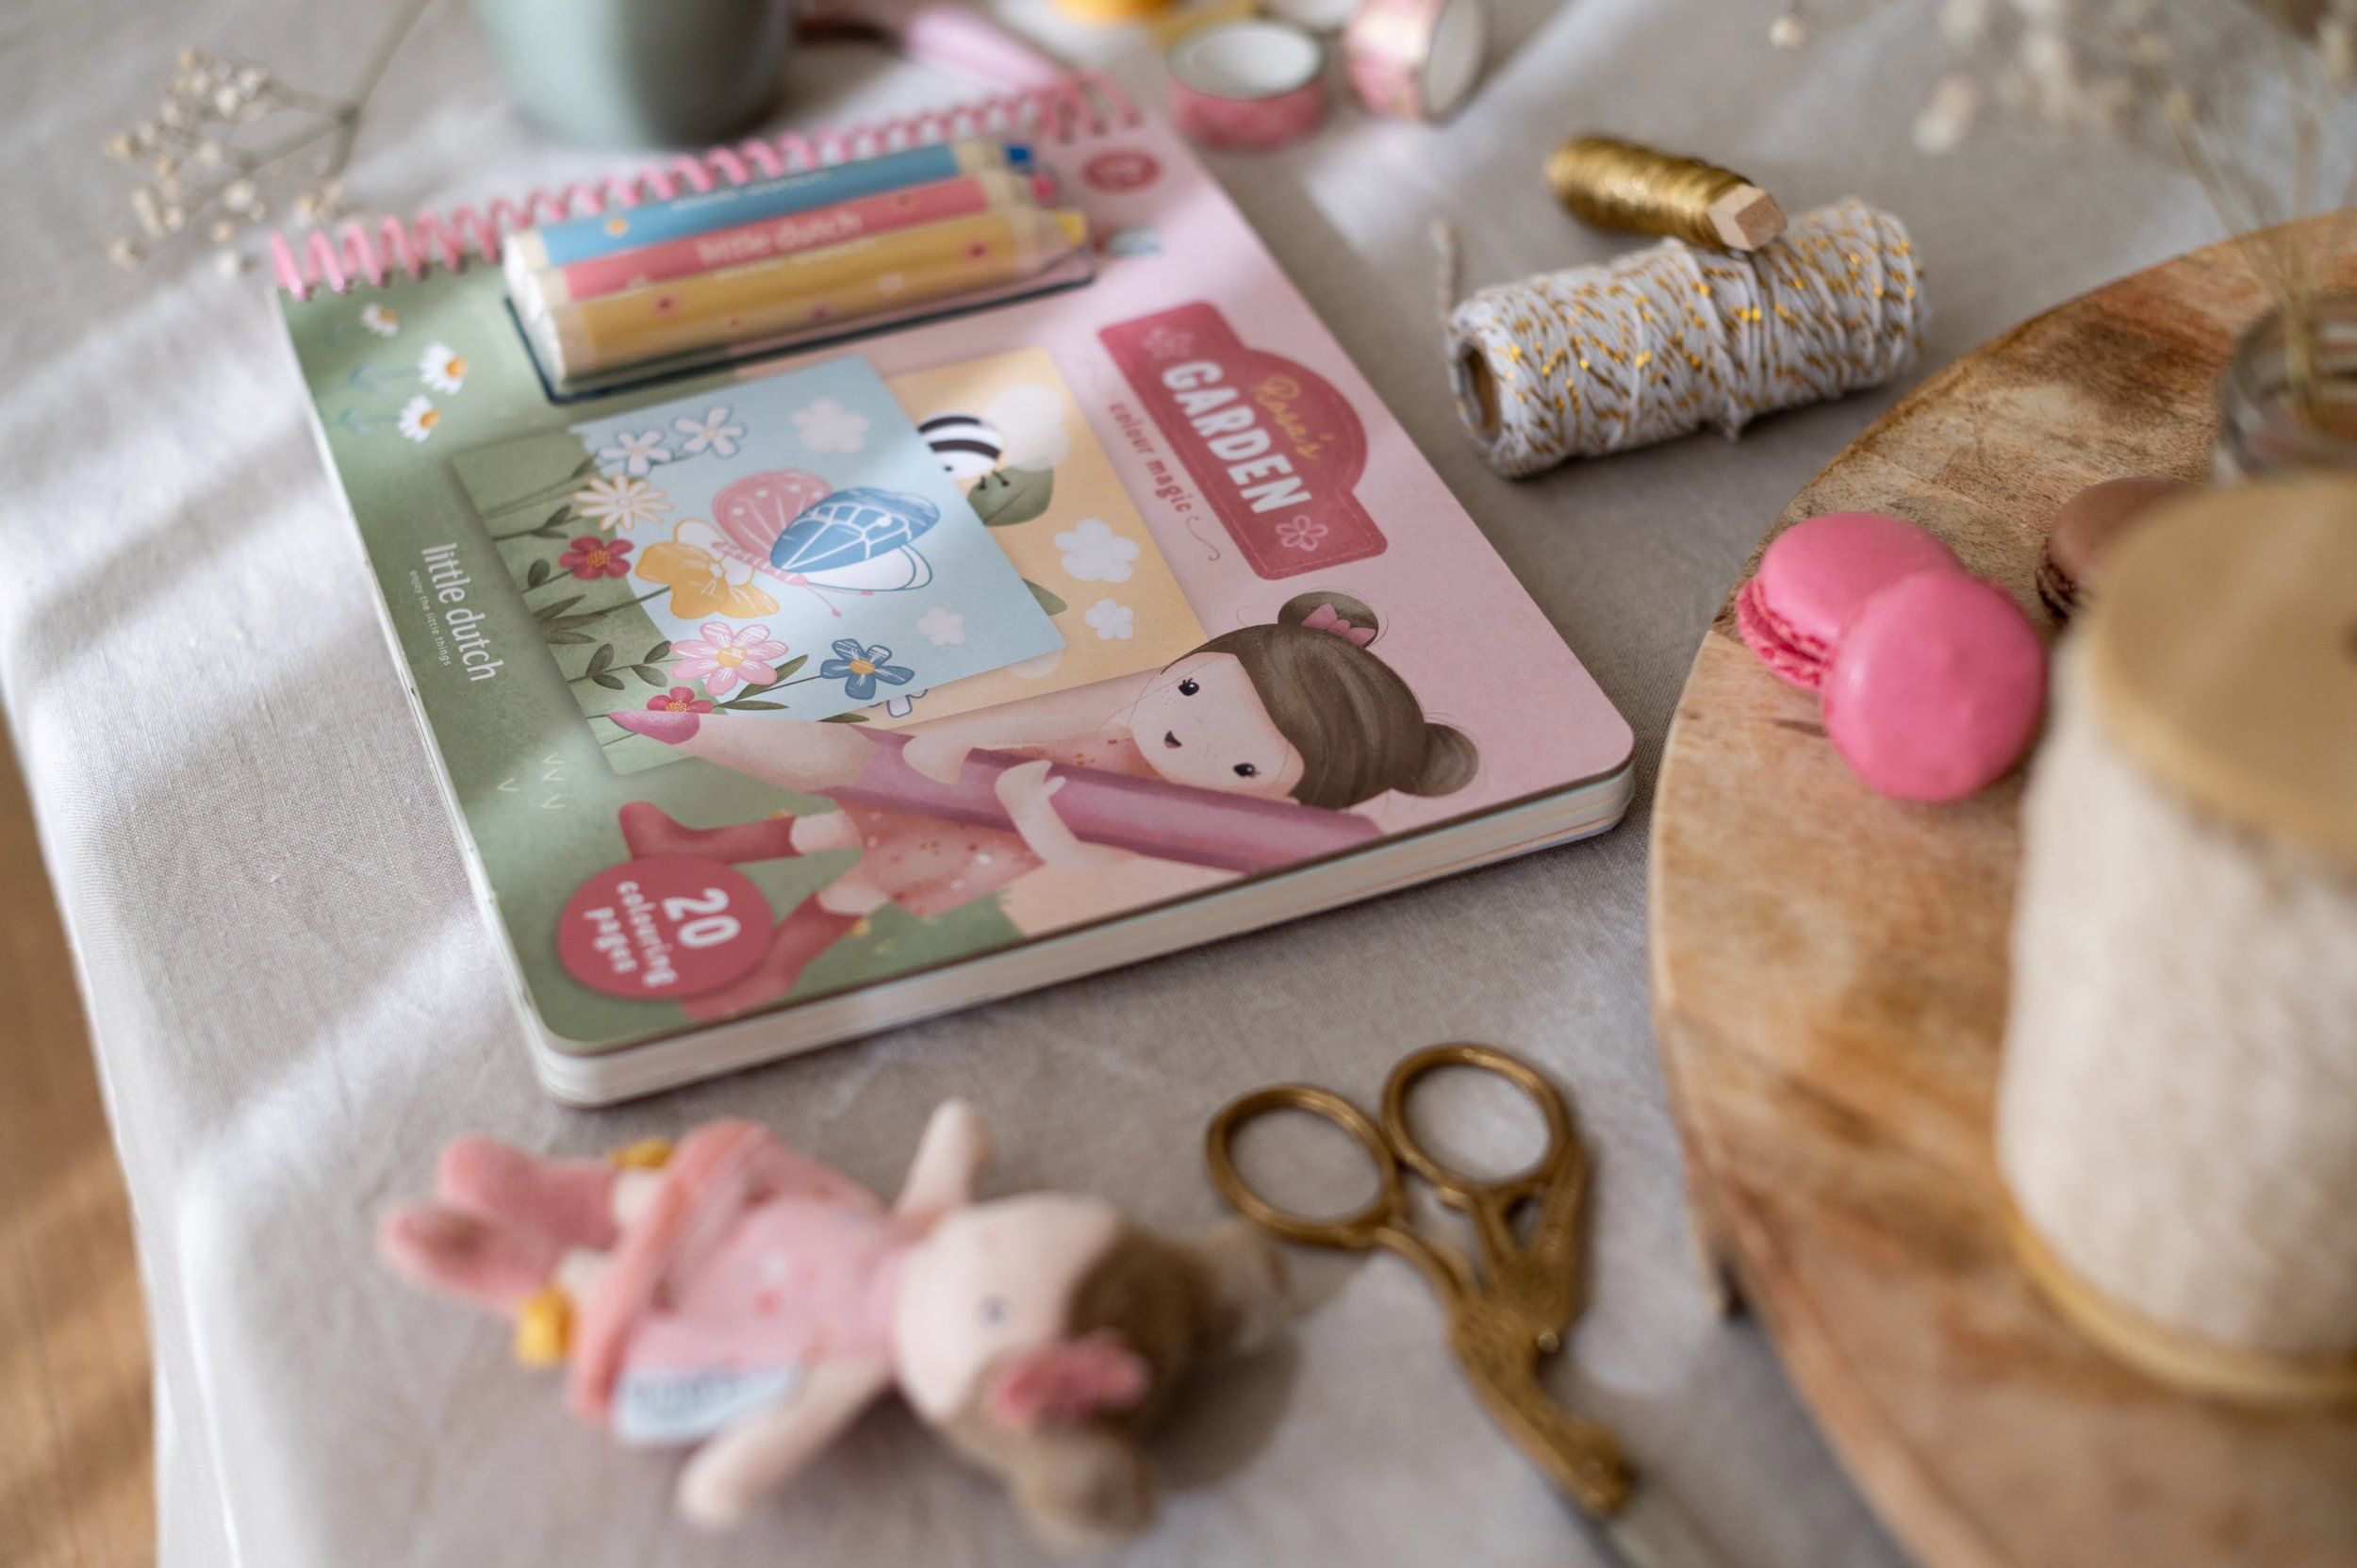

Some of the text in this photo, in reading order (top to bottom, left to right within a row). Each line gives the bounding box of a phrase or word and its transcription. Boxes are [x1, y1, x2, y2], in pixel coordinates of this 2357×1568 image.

[1109, 402, 1193, 512] colour magic
[1162, 360, 1311, 513] GARDEN
[420, 595, 430, 611] the
[426, 612, 439, 635] little
[435, 636, 451, 666] things
[422, 542, 503, 681] little dutch
[582, 906, 638, 973] pages
[617, 881, 679, 988] colouring
[662, 887, 740, 948] 20
